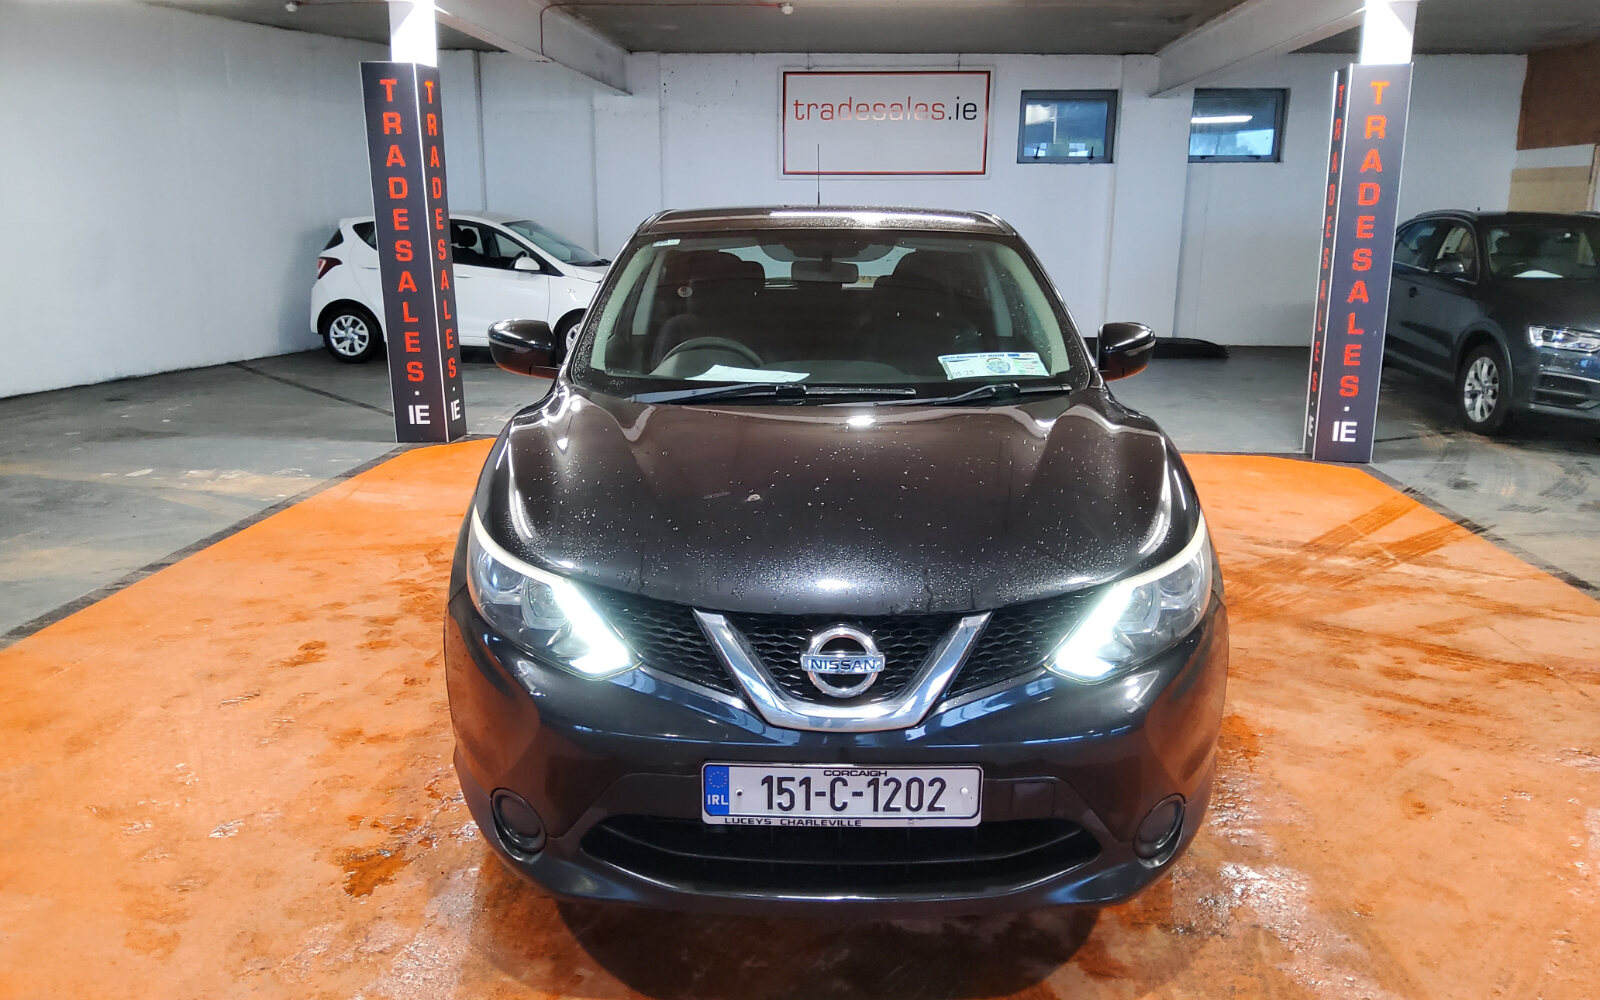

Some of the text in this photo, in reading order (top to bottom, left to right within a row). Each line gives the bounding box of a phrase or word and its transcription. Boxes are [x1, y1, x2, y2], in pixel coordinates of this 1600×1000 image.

[793, 96, 978, 121] tradesales.ie
[811, 659, 876, 670] NISSAN
[823, 769, 888, 777] CORCAIGH
[761, 775, 947, 813] 151-C-1202
[707, 795, 728, 806] IRL
[724, 817, 862, 827] LUCEYS CHARLEVILLE
